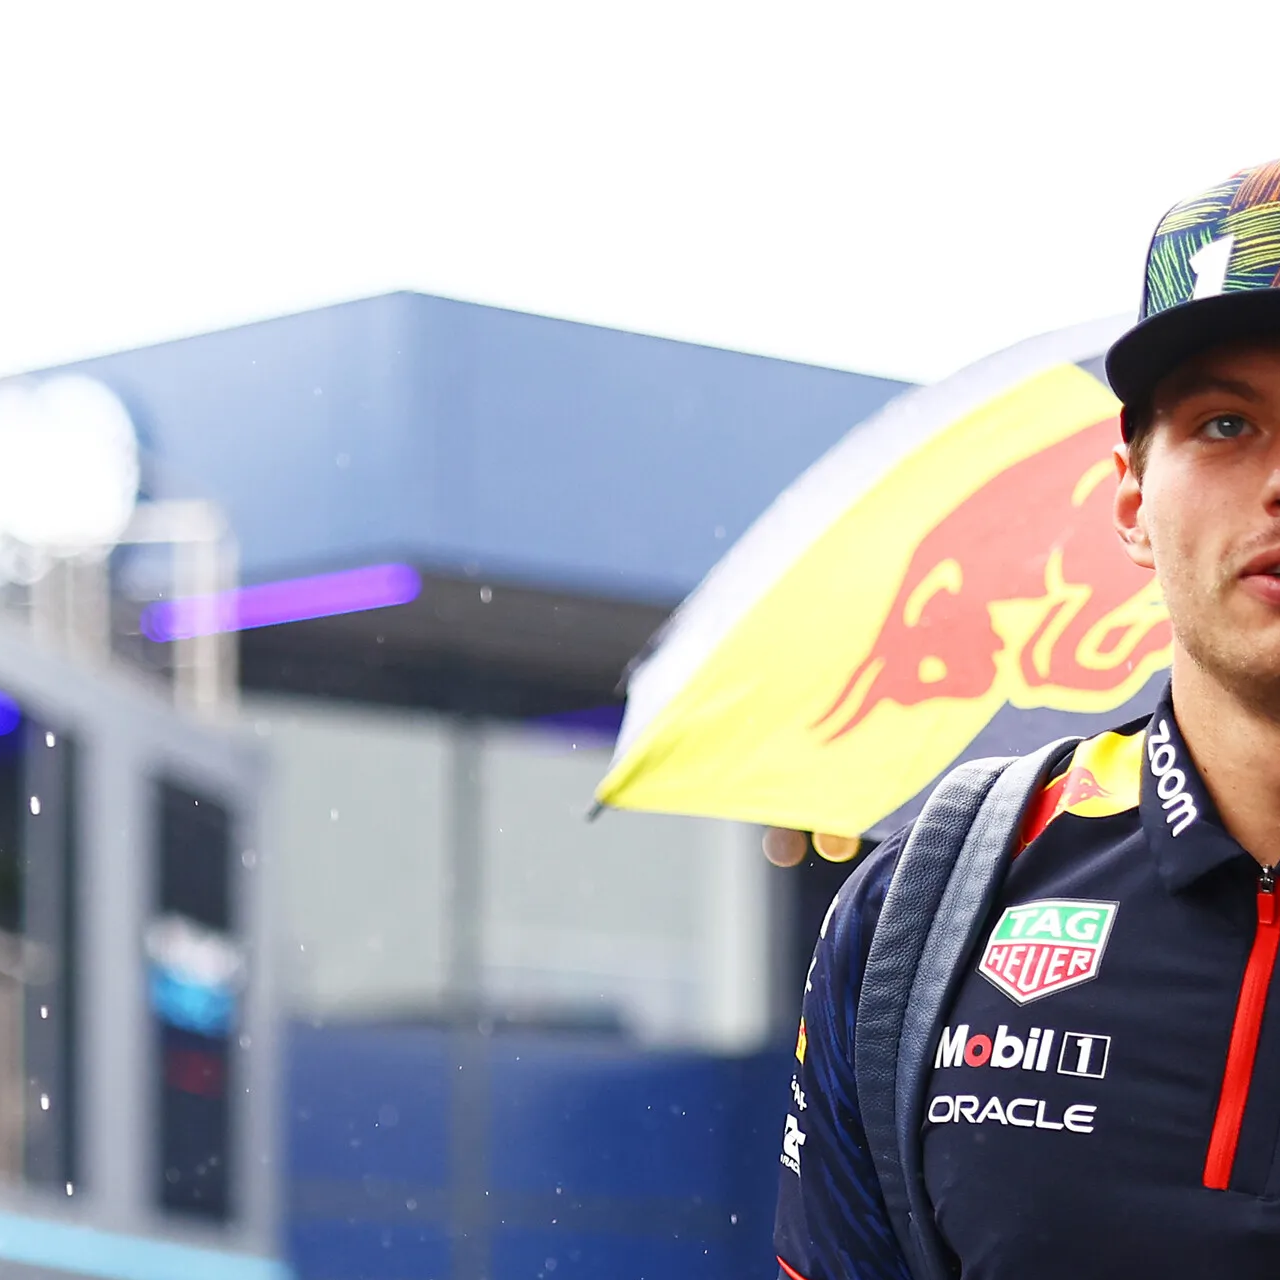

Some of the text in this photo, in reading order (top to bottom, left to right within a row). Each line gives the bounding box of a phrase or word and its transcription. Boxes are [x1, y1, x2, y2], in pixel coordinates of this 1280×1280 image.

[1146, 719, 1199, 838] zoom
[1008, 907, 1102, 943] TAG
[987, 946, 1093, 989] HEUER
[934, 1023, 1055, 1072] Mobil
[927, 1093, 1098, 1135] ORACLE
